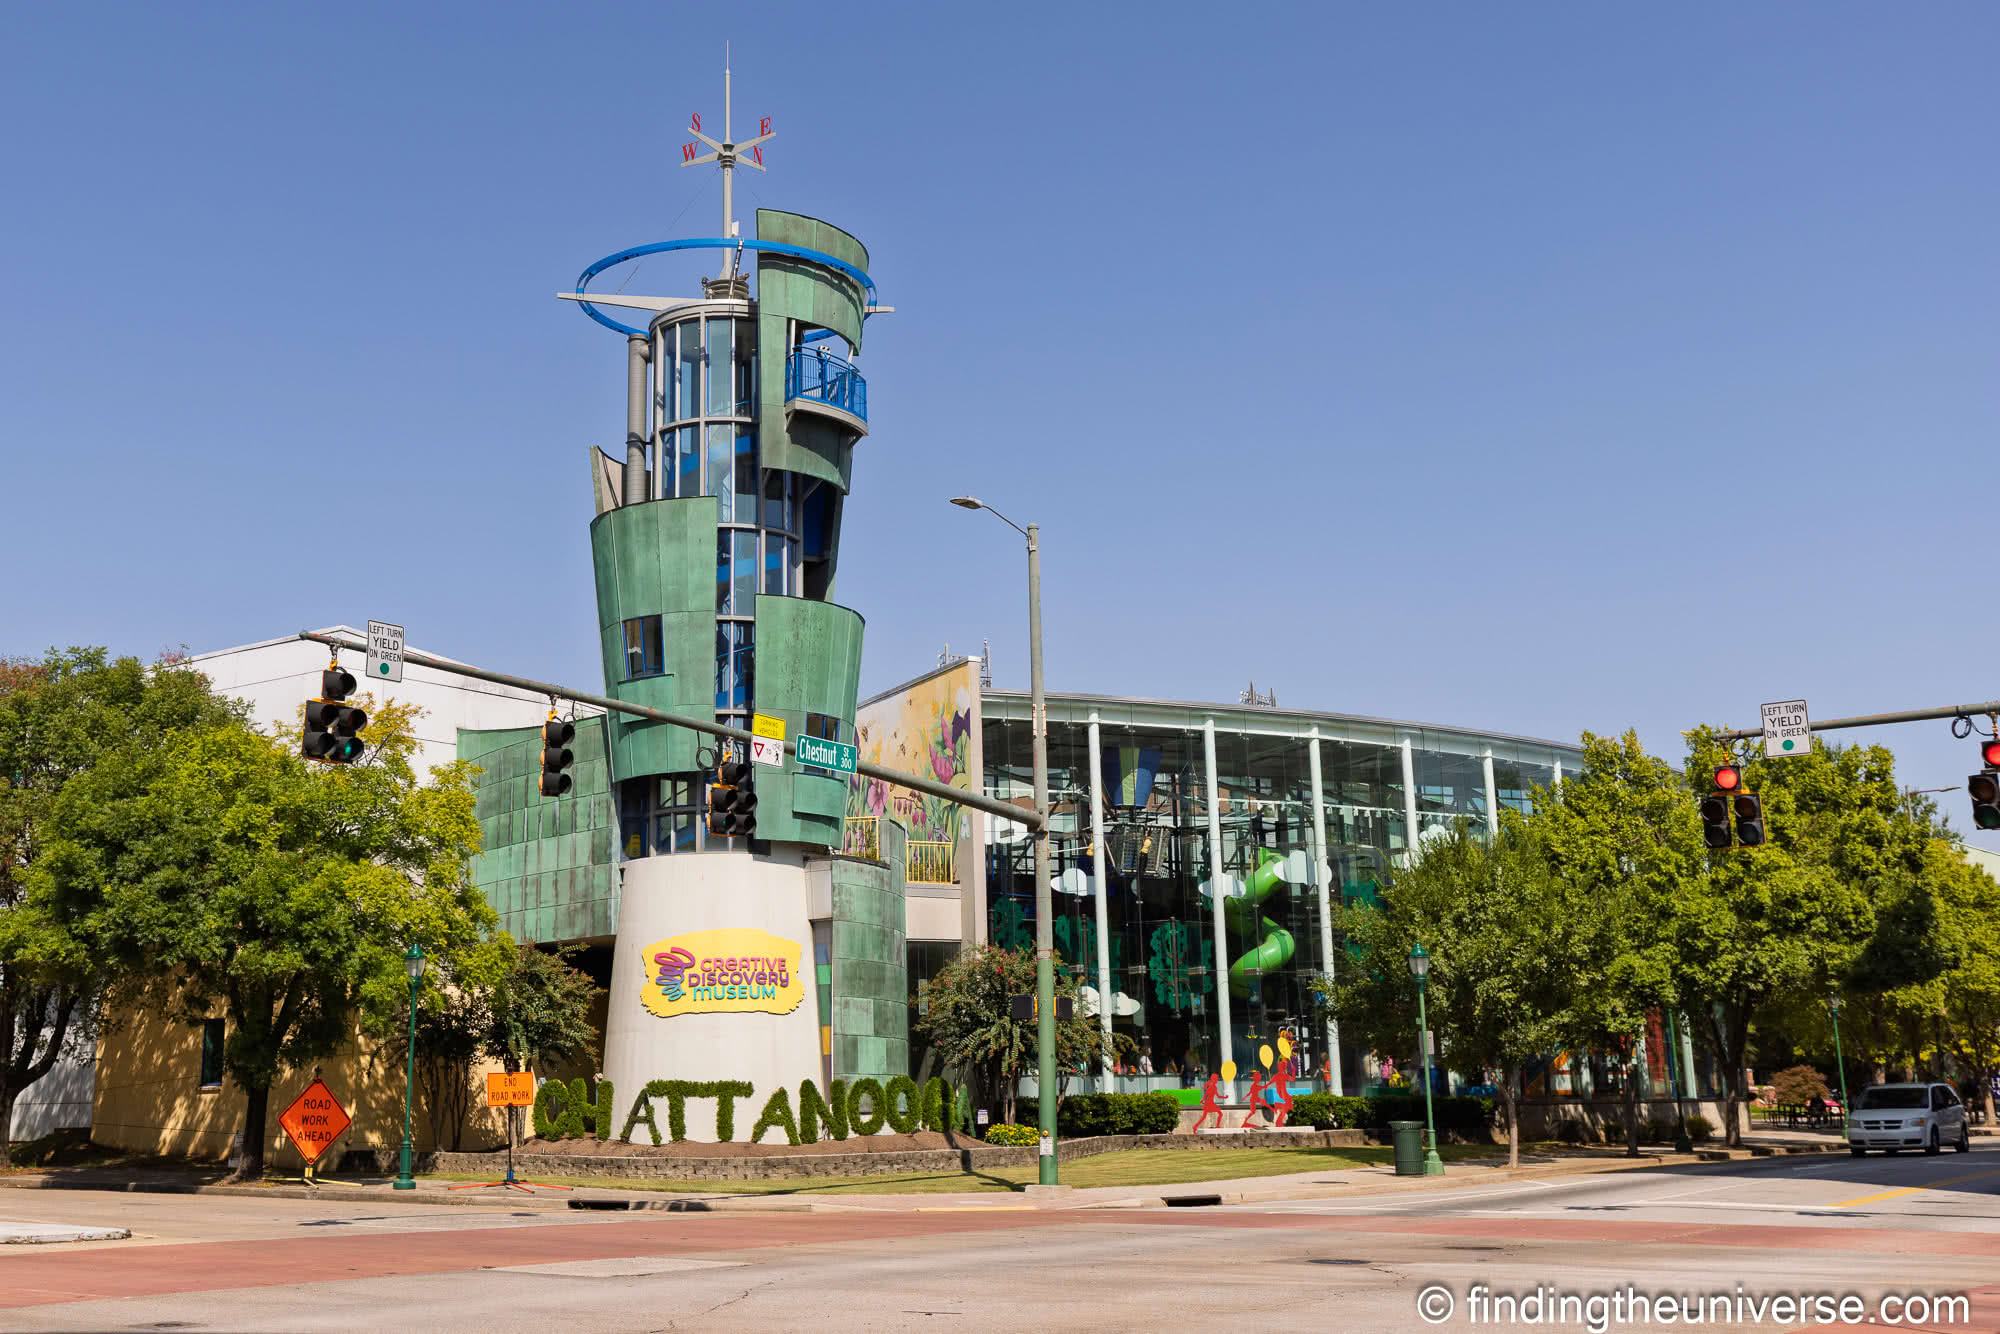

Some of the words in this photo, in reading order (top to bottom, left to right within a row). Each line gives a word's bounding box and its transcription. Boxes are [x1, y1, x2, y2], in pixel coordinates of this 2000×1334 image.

[692, 112, 702, 132] S
[760, 116, 772, 136] E
[682, 140, 700, 162] W
[753, 145, 763, 166] N
[369, 624, 385, 636] LEFT
[386, 627, 403, 639] TURN
[373, 636, 399, 651] YIELD
[369, 648, 378, 659] ON
[380, 650, 402, 663] GREEN
[1763, 706, 1781, 717] LEFT
[1784, 704, 1805, 714] TURN
[1769, 715, 1802, 728] YIELD
[1766, 730, 1778, 739] ON
[1781, 727, 1808, 738] GREEN
[799, 738, 837, 766] Chestnut
[843, 747, 850, 758] St
[840, 757, 852, 769] 300
[504, 1077, 517, 1087] END
[491, 1091, 509, 1101] ROAD
[511, 1090, 530, 1100] WORK
[303, 1099, 331, 1110] ROAD
[302, 1114, 329, 1126] WORK
[297, 1131, 332, 1142] AHEAD
